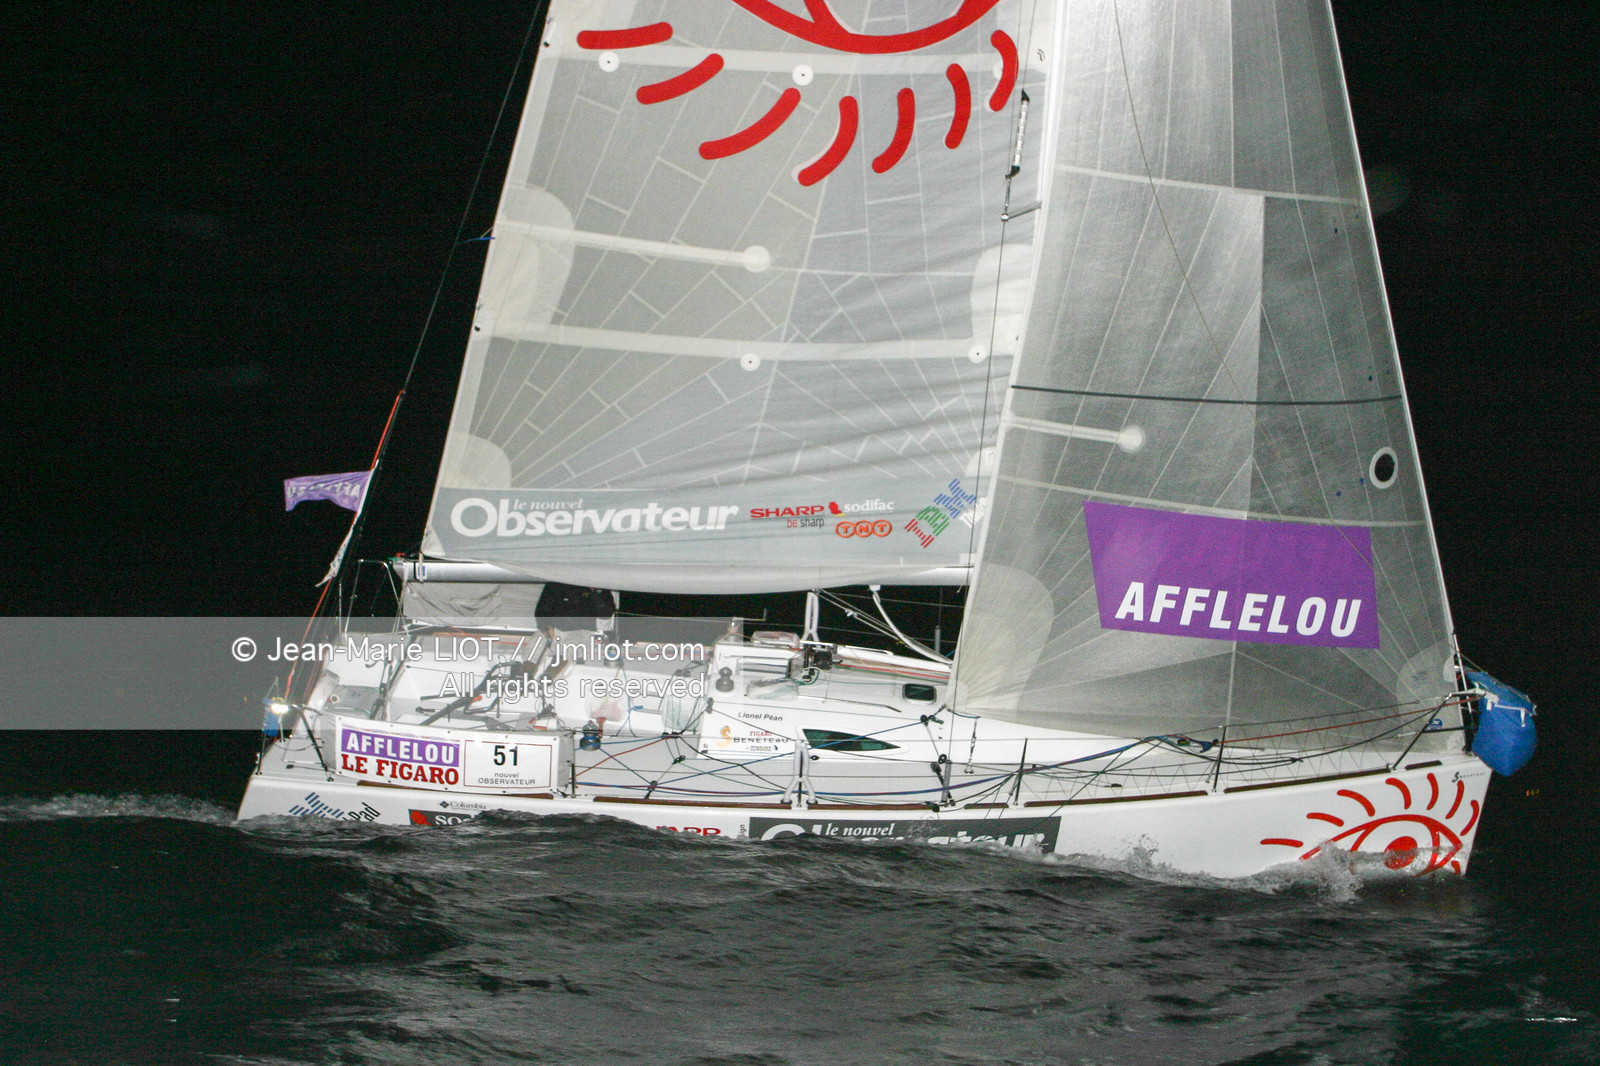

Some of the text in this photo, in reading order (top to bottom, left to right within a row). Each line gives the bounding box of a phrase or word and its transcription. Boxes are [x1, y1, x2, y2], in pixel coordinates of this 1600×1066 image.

[513, 499, 583, 510] le nouvel
[843, 499, 895, 513] sodifac
[450, 497, 740, 538] Observateur
[750, 505, 825, 518] SHARP
[786, 516, 825, 529] be sharp
[838, 522, 889, 535] TNT
[1115, 581, 1362, 637] AFFLELOU
[738, 712, 762, 720] Lionel
[346, 733, 455, 765] AFFLELOU
[493, 745, 518, 766] 51
[341, 753, 459, 785] LE FIGARO
[478, 777, 536, 785] OBSERVATEUR
[450, 801, 487, 809] Columbia
[825, 823, 838, 836] le
[843, 823, 896, 836] nouvel
